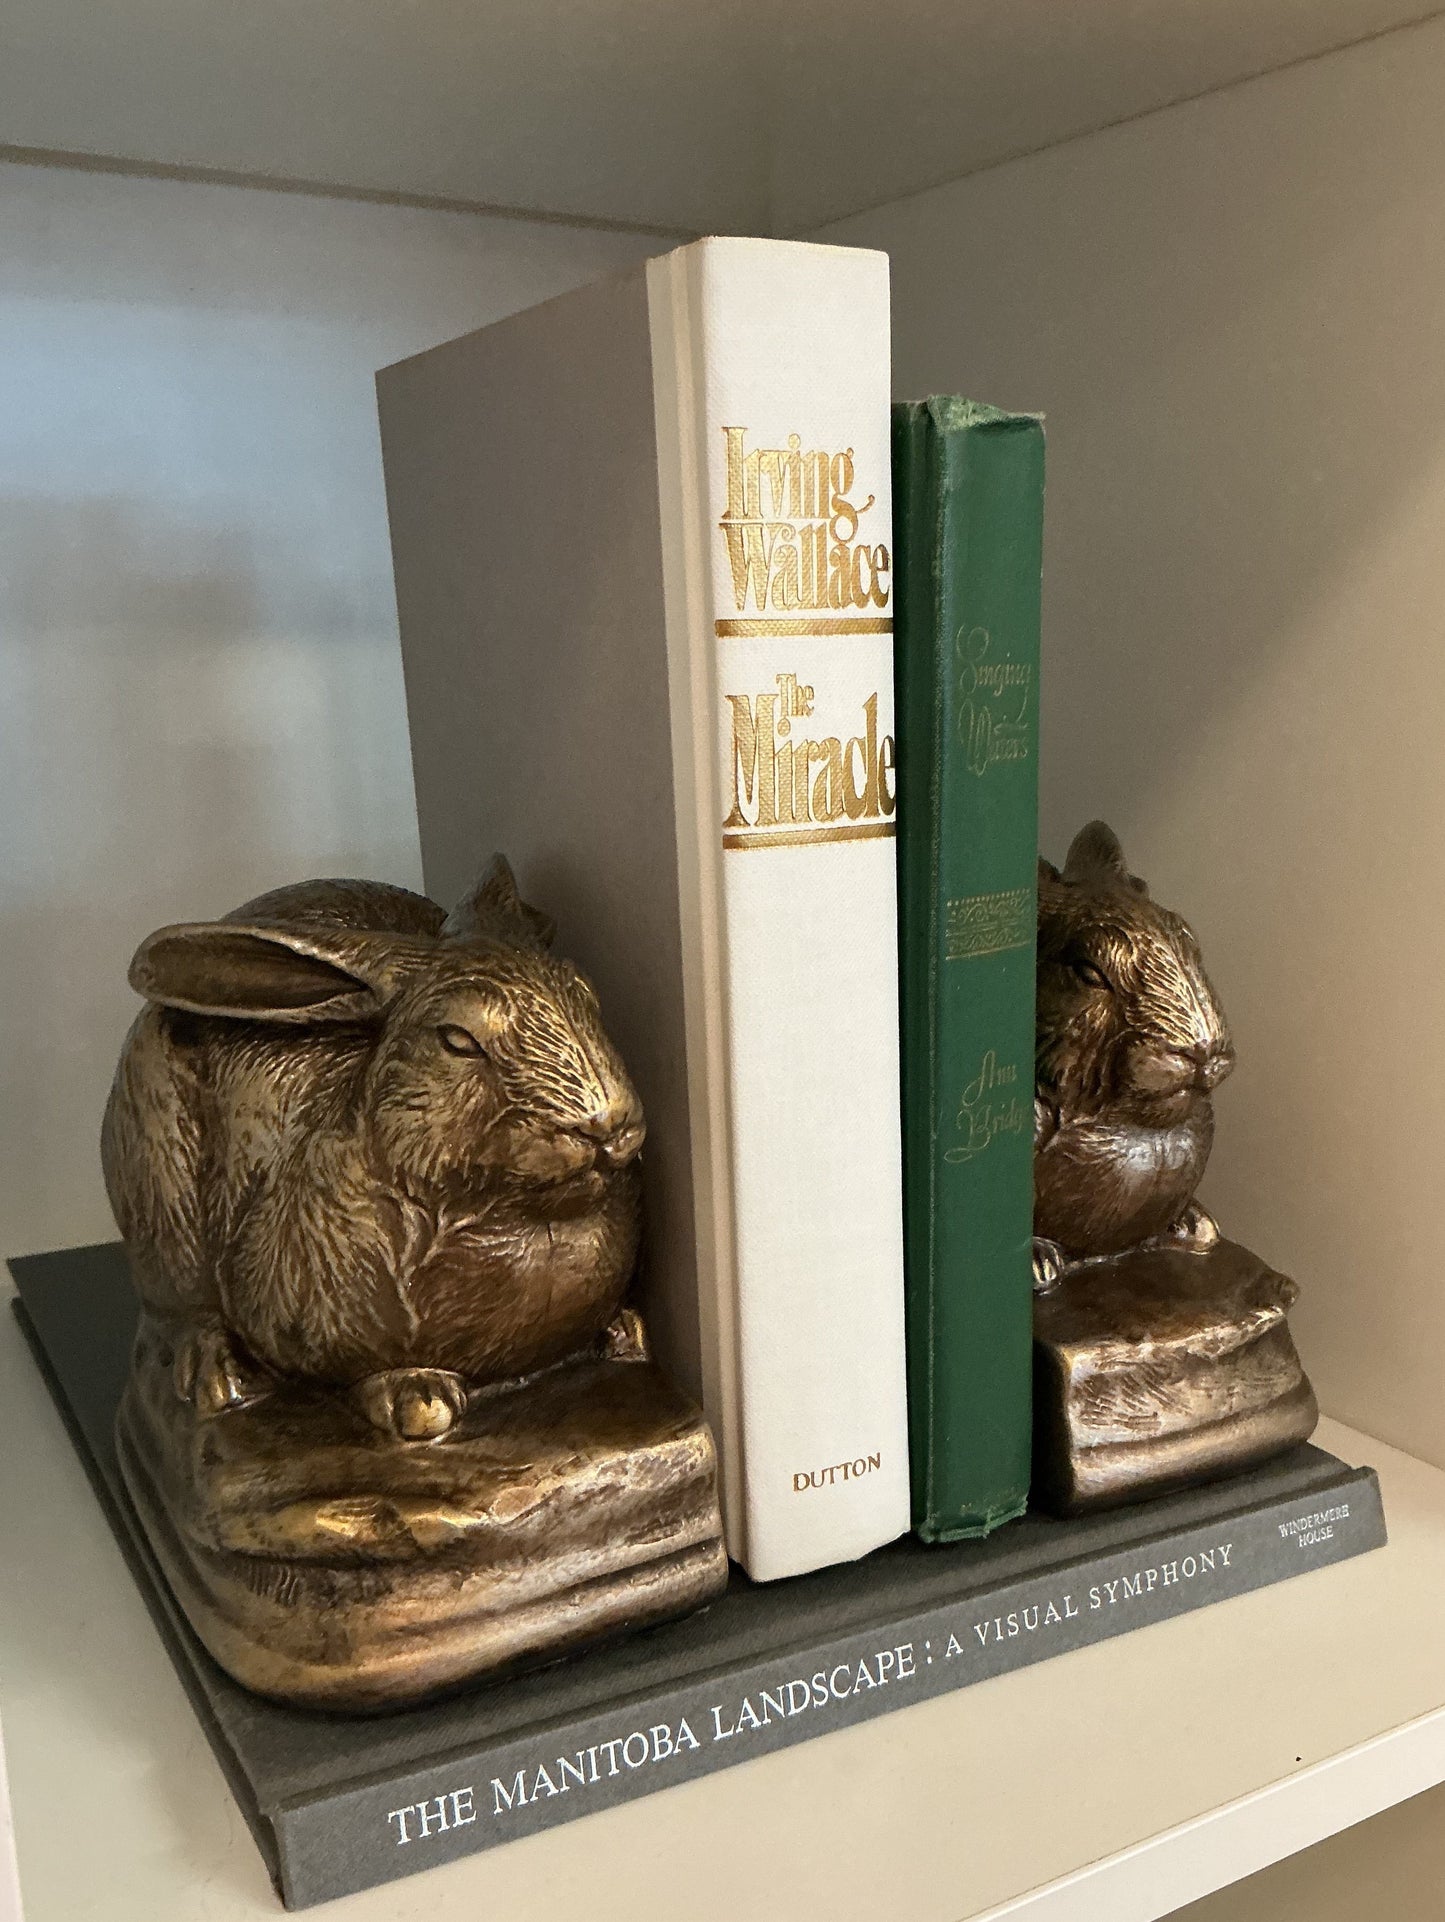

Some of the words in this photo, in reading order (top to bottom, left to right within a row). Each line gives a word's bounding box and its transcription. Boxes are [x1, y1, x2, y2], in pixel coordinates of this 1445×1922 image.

[720, 426, 875, 544] Irving
[718, 523, 892, 611] Wallace
[775, 673, 814, 717] The
[722, 692, 896, 828] Miracle
[793, 1452, 881, 1492] DUTTON
[1278, 1504, 1350, 1538] WINDERMERE
[1298, 1525, 1334, 1547] HOUSE
[388, 1787, 478, 1845] THE
[490, 1717, 701, 1815] MANITOBA
[945, 1634, 963, 1658] A
[973, 1595, 1079, 1646] VISUAL
[1089, 1544, 1233, 1609] SYMPHONY
